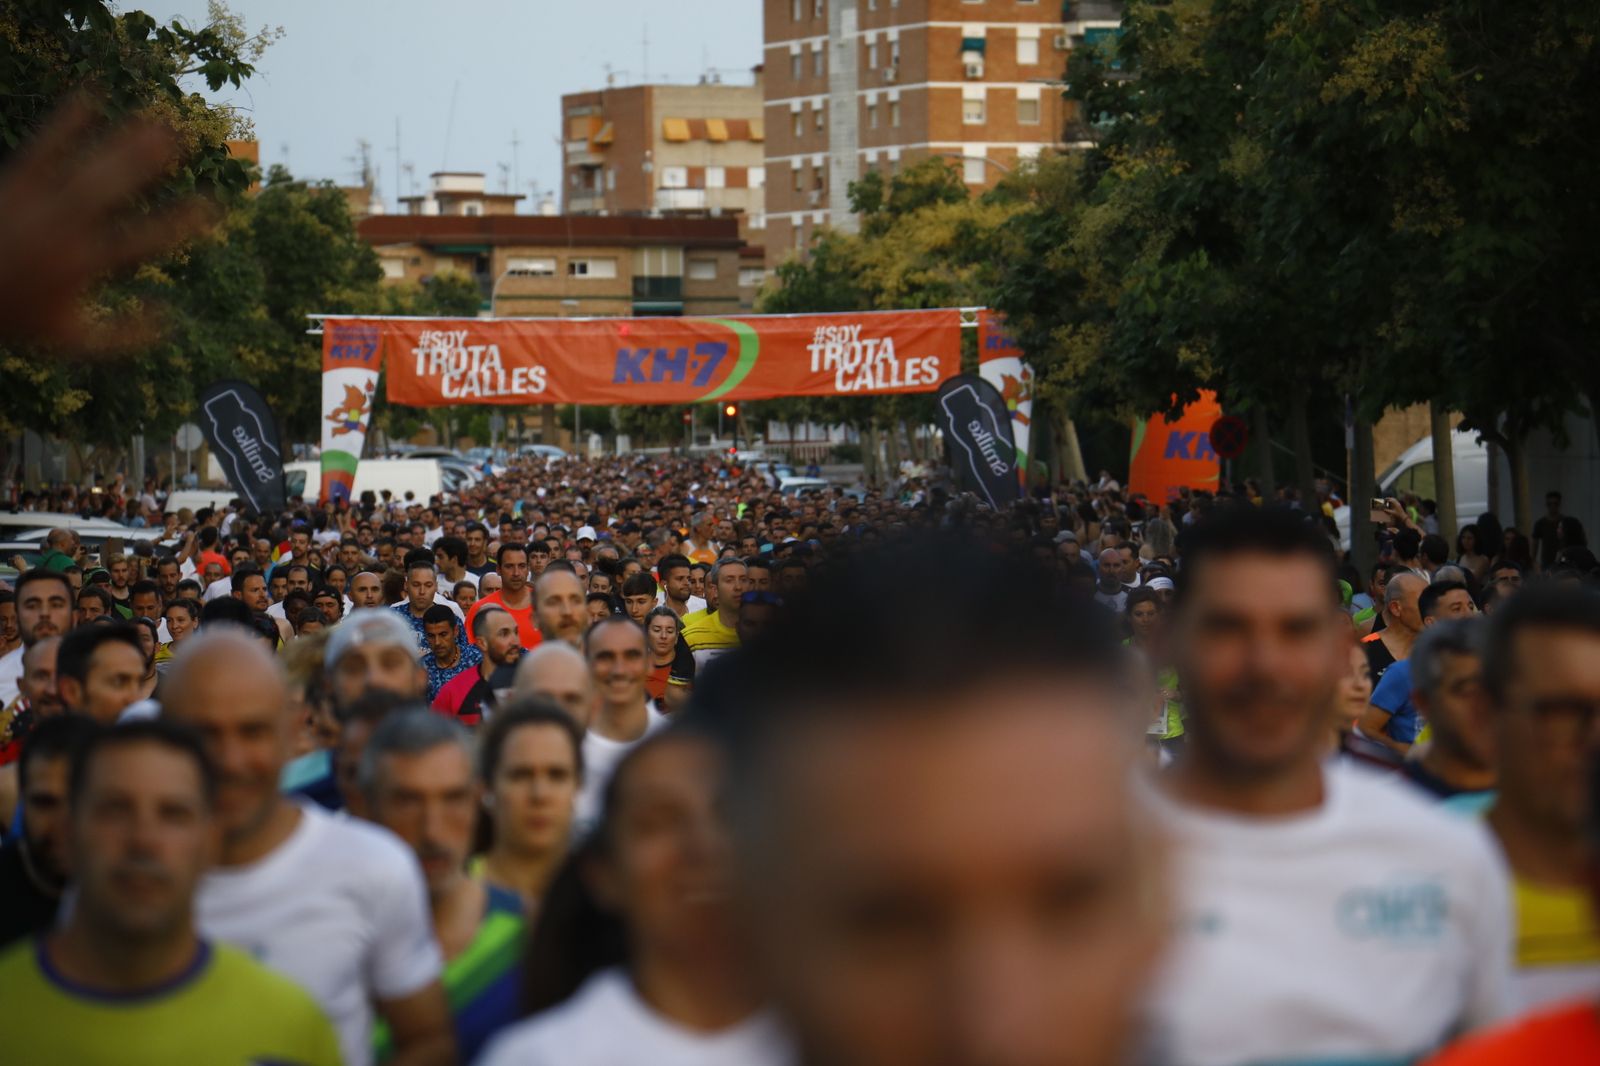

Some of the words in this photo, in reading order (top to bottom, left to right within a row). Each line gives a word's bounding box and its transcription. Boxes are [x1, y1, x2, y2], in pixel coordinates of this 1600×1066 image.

[419, 330, 469, 348] #SOY
[813, 325, 862, 345] #SOY
[412, 344, 502, 377] TROTA
[807, 337, 897, 373] TROTA
[442, 365, 547, 398] CALLES
[835, 356, 940, 392] CALLES
